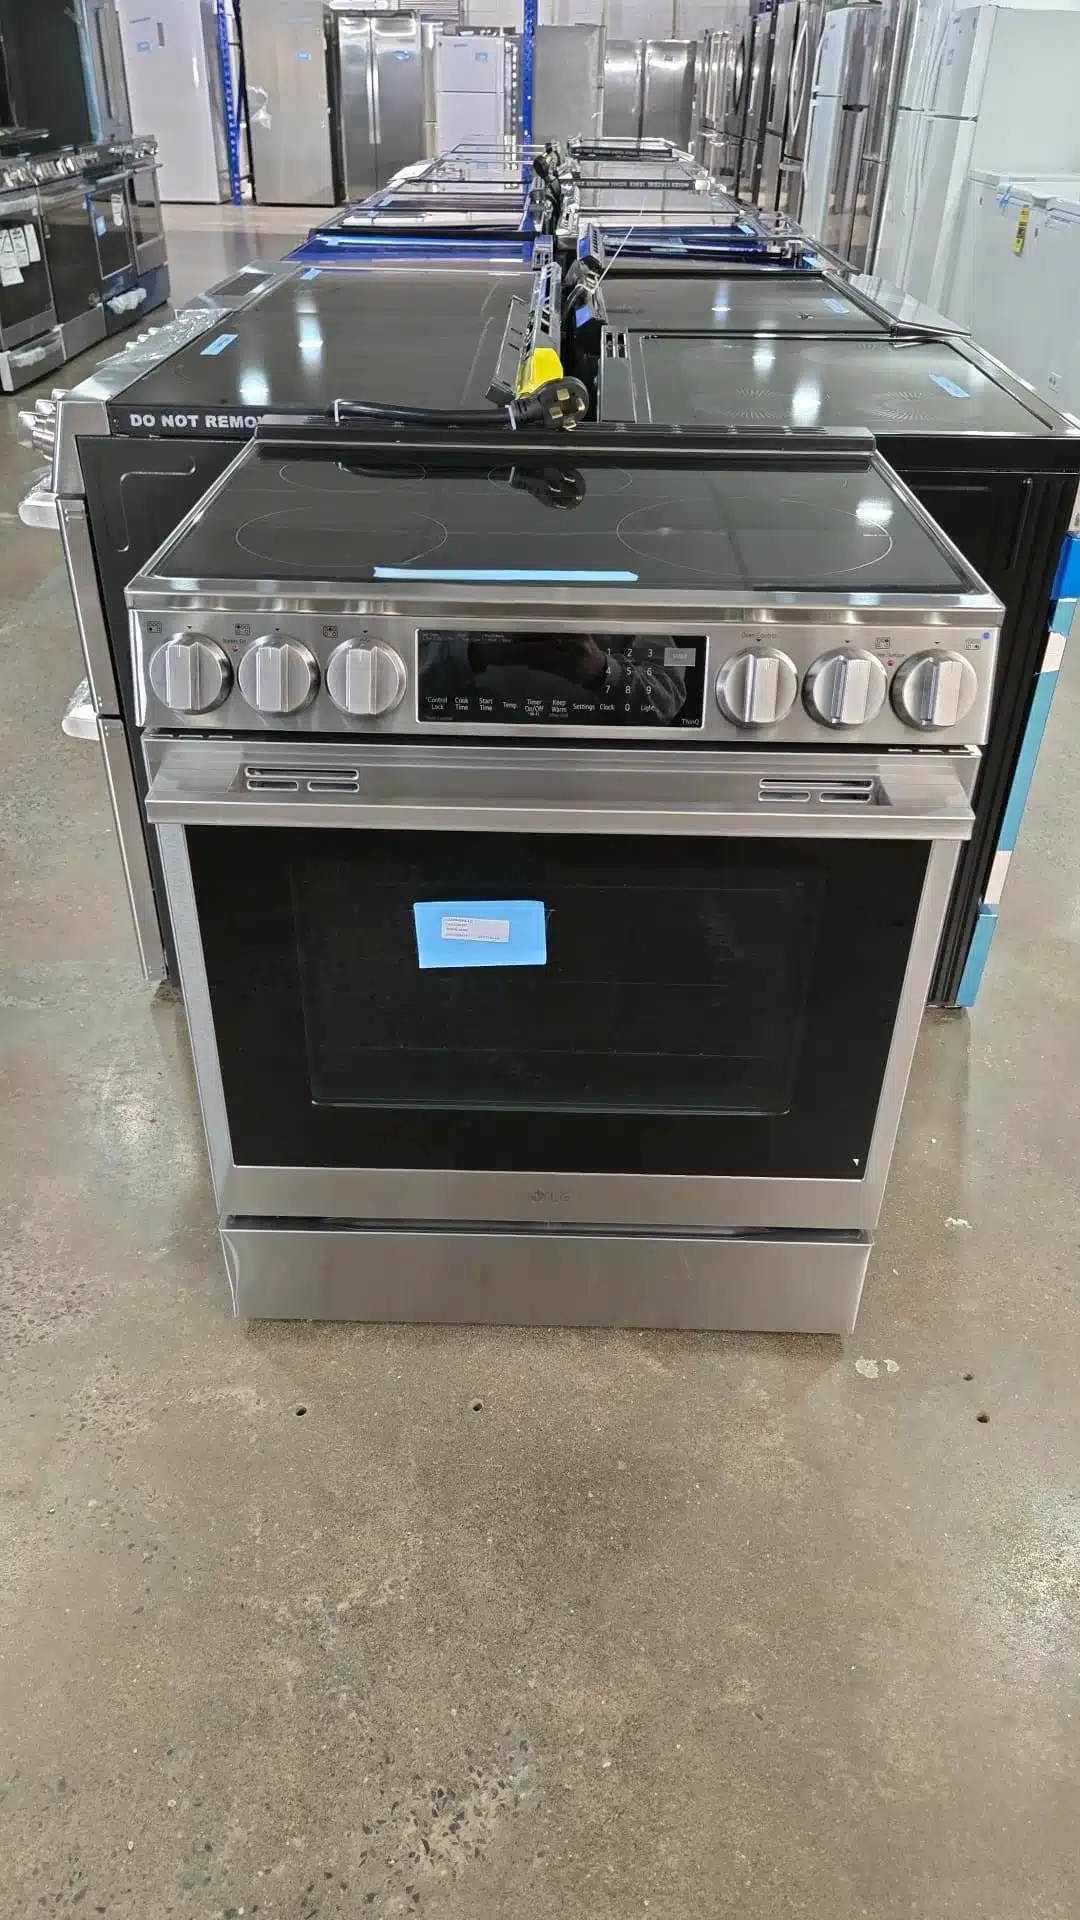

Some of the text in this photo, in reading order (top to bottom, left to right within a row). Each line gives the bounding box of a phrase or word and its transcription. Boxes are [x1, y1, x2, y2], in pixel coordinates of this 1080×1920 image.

[130, 414, 156, 427] DO
[161, 414, 199, 428] NOT
[607, 648, 653, 657] 1 2 3
[605, 666, 652, 676] 4 5 6
[605, 685, 652, 694] 7 8 9
[572, 703, 595, 712] Settings
[624, 703, 631, 712] 0
